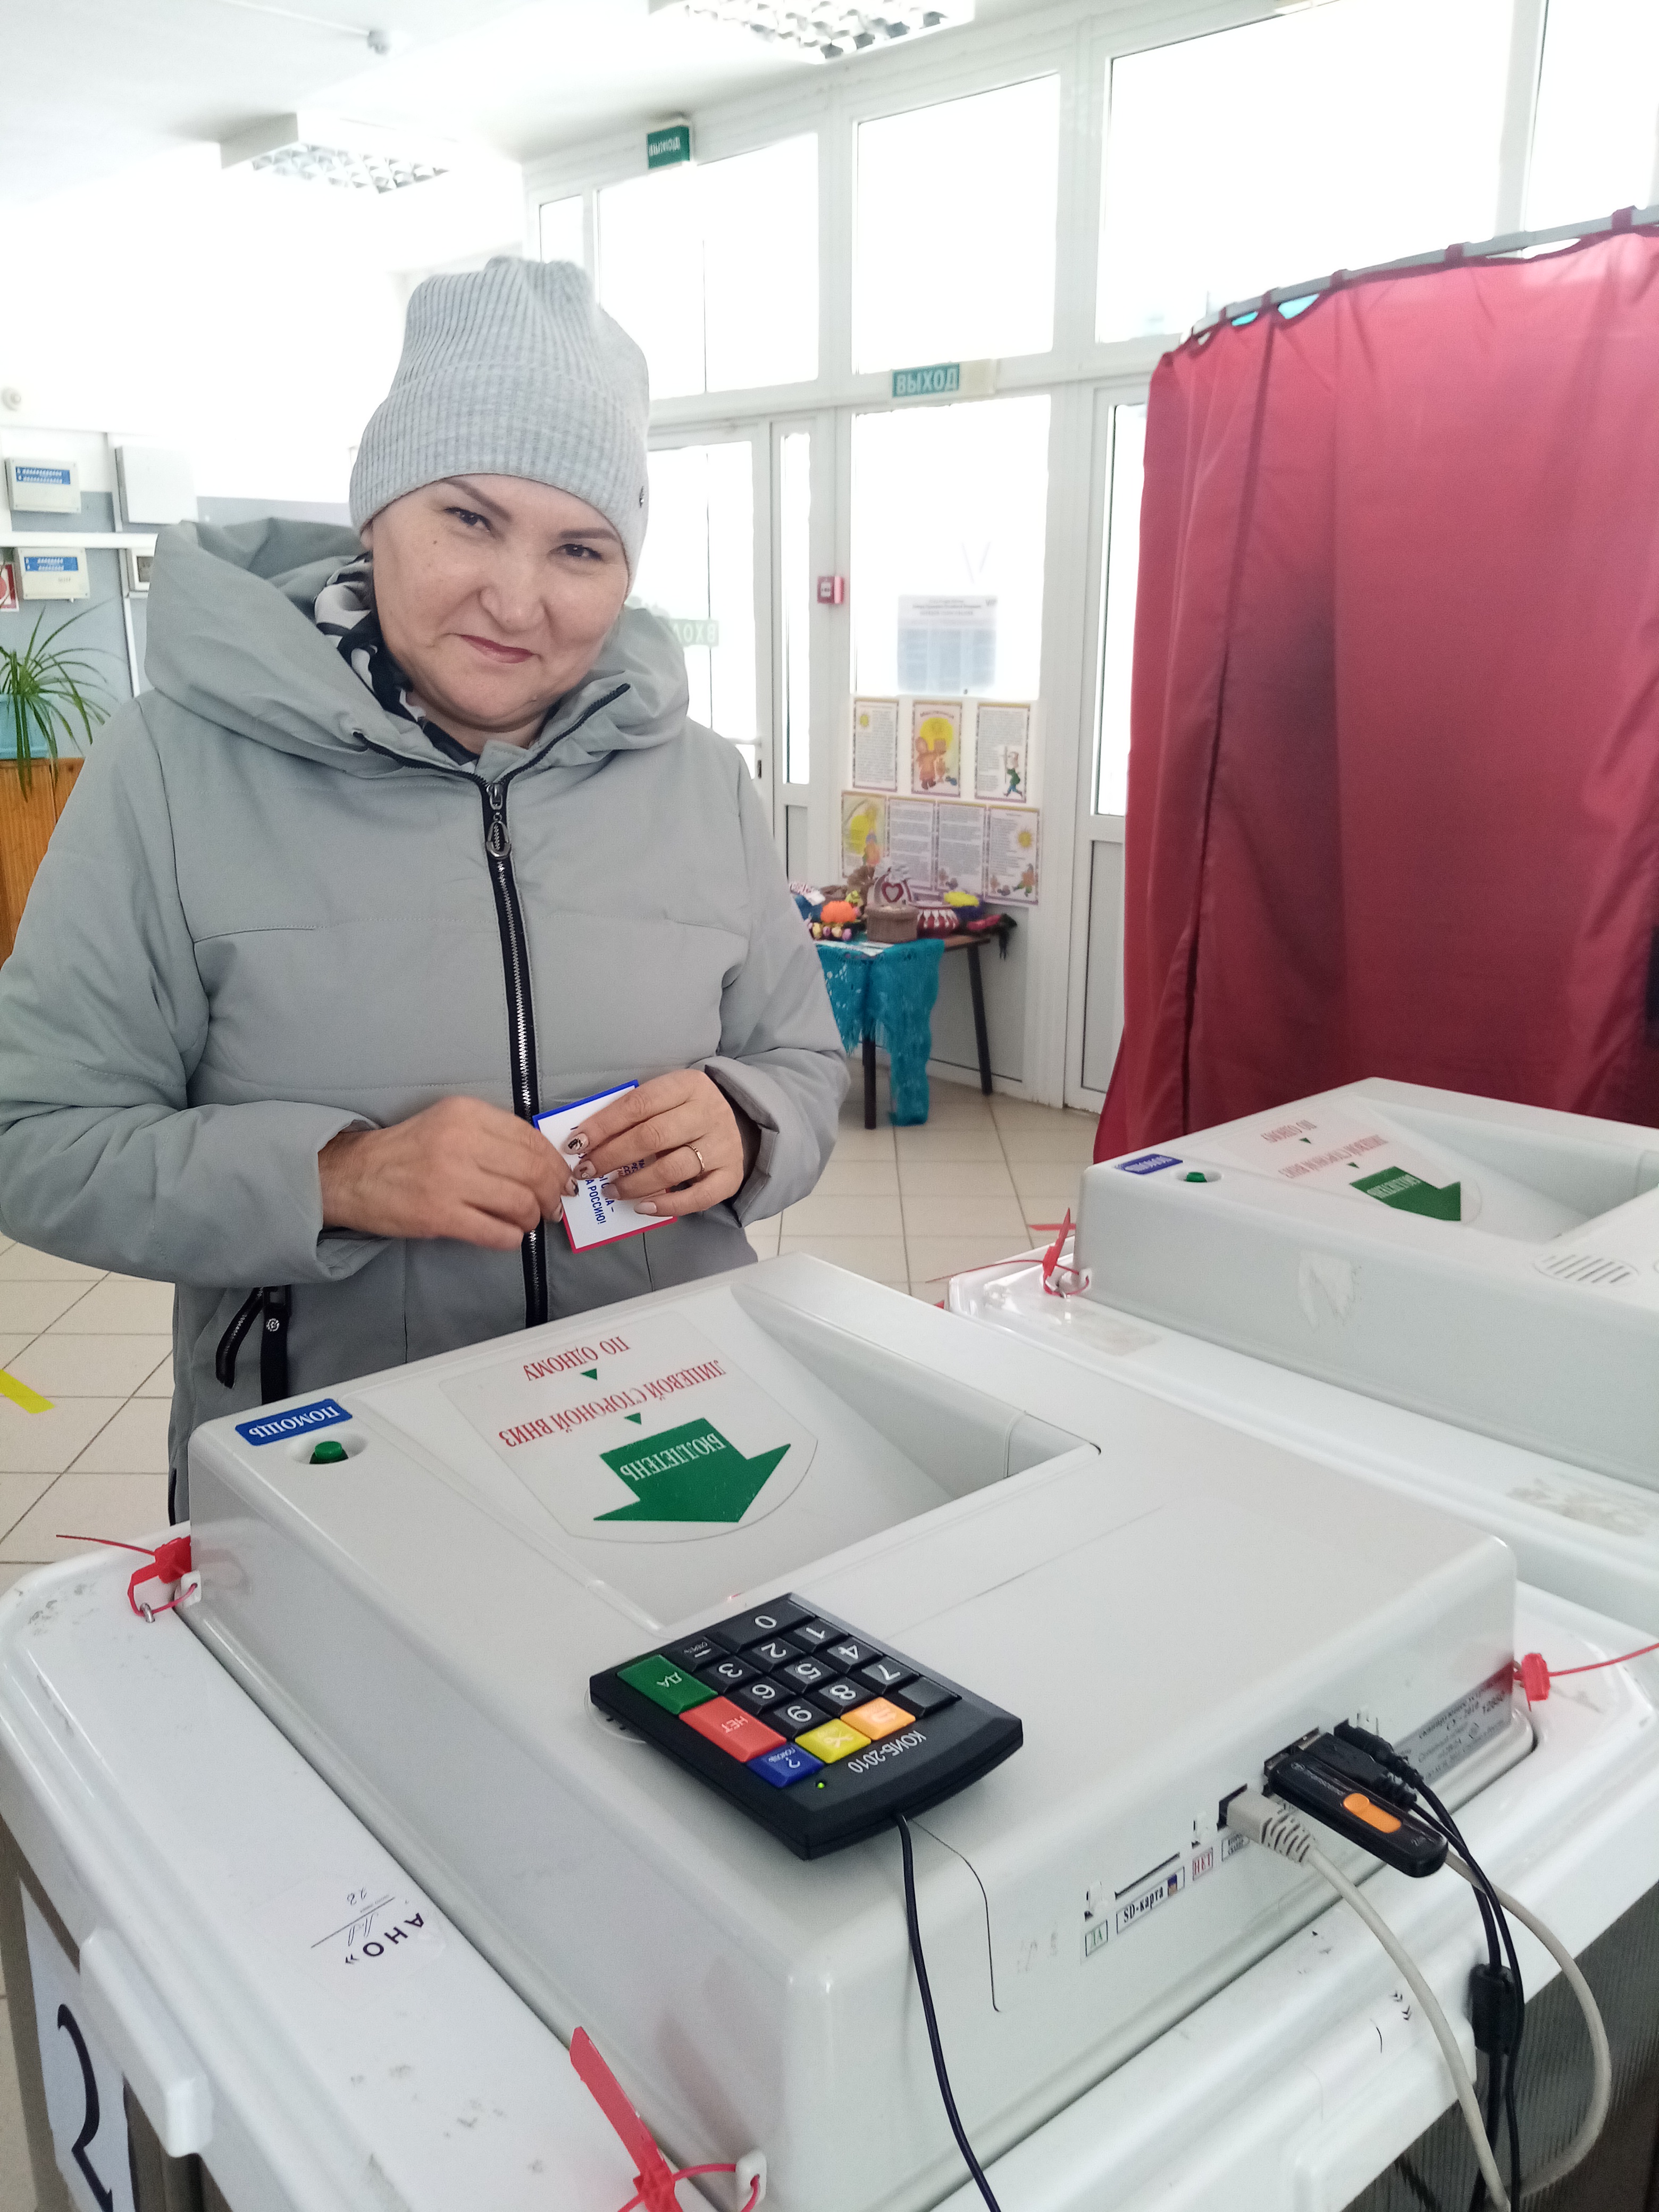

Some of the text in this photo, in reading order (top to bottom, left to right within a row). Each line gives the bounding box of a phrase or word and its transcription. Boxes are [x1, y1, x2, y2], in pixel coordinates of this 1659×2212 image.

[896, 368, 958, 394] ВЫХОД
[588, 1185, 606, 1225] РОССИЮ!
[523, 1336, 631, 1381] ПО ОДНОМУ
[498, 1360, 727, 1447] ЛИЦЕВОЙ СТОРОНОЙ ВНИЗ
[249, 1406, 341, 1438] ПОМОЩЬ
[620, 1433, 727, 1481] БЮЛЛЕТЕНЬ
[755, 1615, 777, 1629] 0
[804, 1626, 826, 1640] 1
[761, 1643, 787, 1660] 2
[836, 1644, 859, 1660] 4
[657, 1672, 683, 1688] ДА
[719, 1663, 743, 1679] 3
[797, 1663, 823, 1681] 5
[875, 1664, 900, 1680] 7
[751, 1683, 776, 1700] 6
[830, 1683, 856, 1700] 8
[787, 1705, 812, 1722] 9
[720, 1715, 749, 1734] НЕТ
[849, 1730, 927, 1774] КОИБ-2010
[1193, 1854, 1212, 1876] НЕТ
[1123, 1886, 1163, 1923] SD-карта
[1089, 1928, 1103, 1946] ДА
